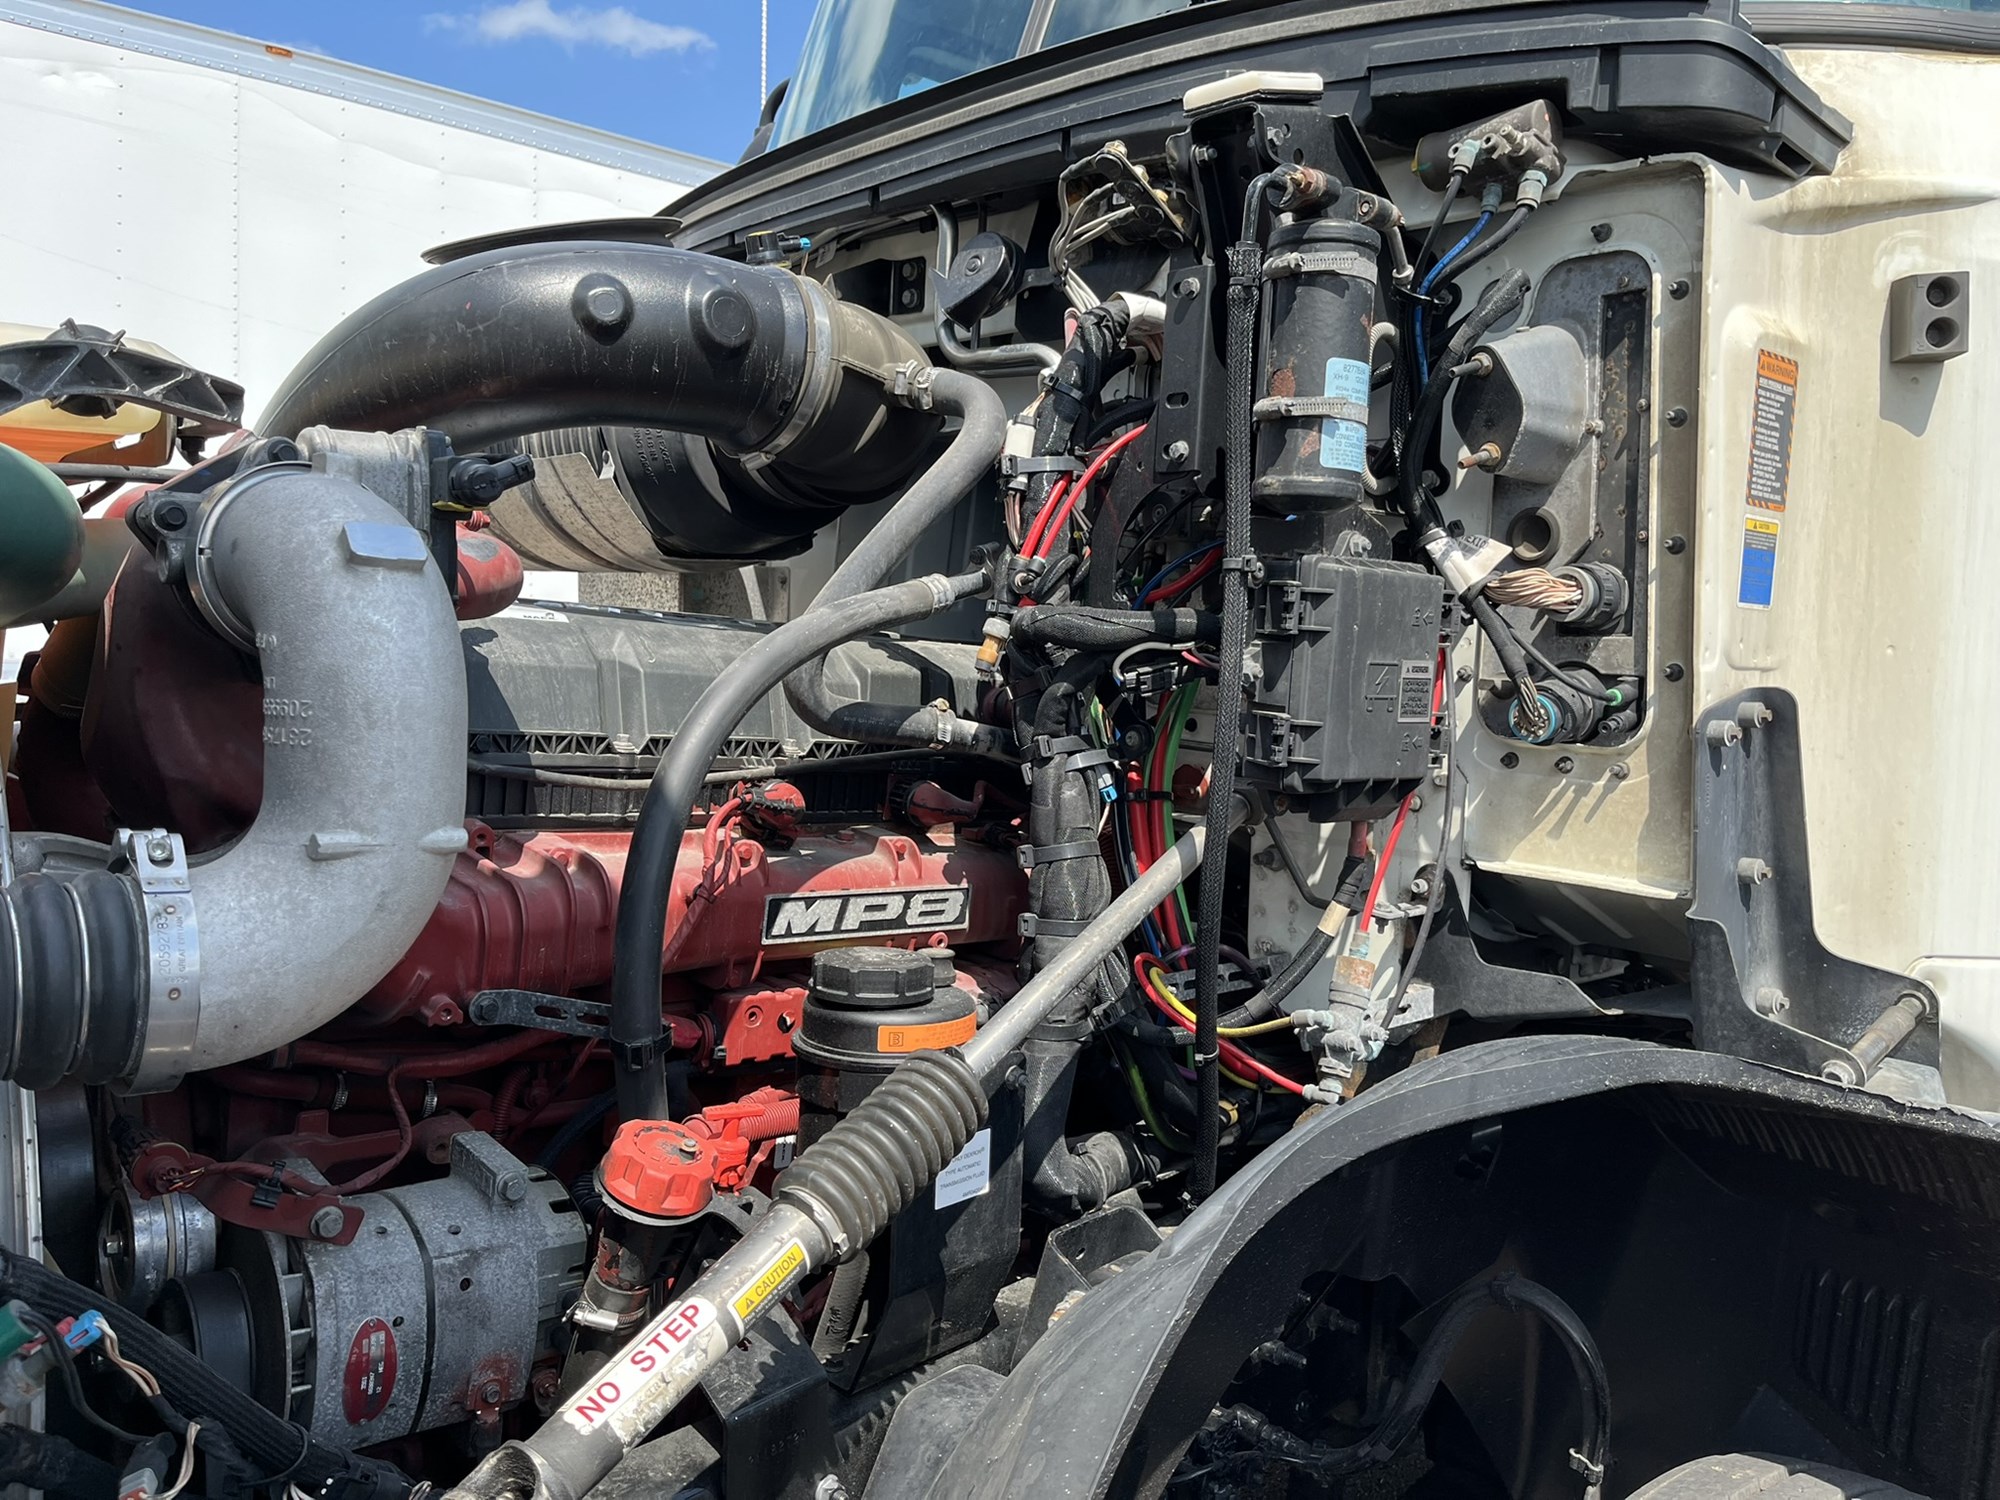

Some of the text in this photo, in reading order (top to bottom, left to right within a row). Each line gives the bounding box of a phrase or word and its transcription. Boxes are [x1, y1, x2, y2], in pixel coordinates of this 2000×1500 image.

[771, 891, 965, 936] MP8
[755, 1251, 797, 1297] CAUTION
[575, 1381, 621, 1424] NO
[630, 1304, 700, 1373] STEP
